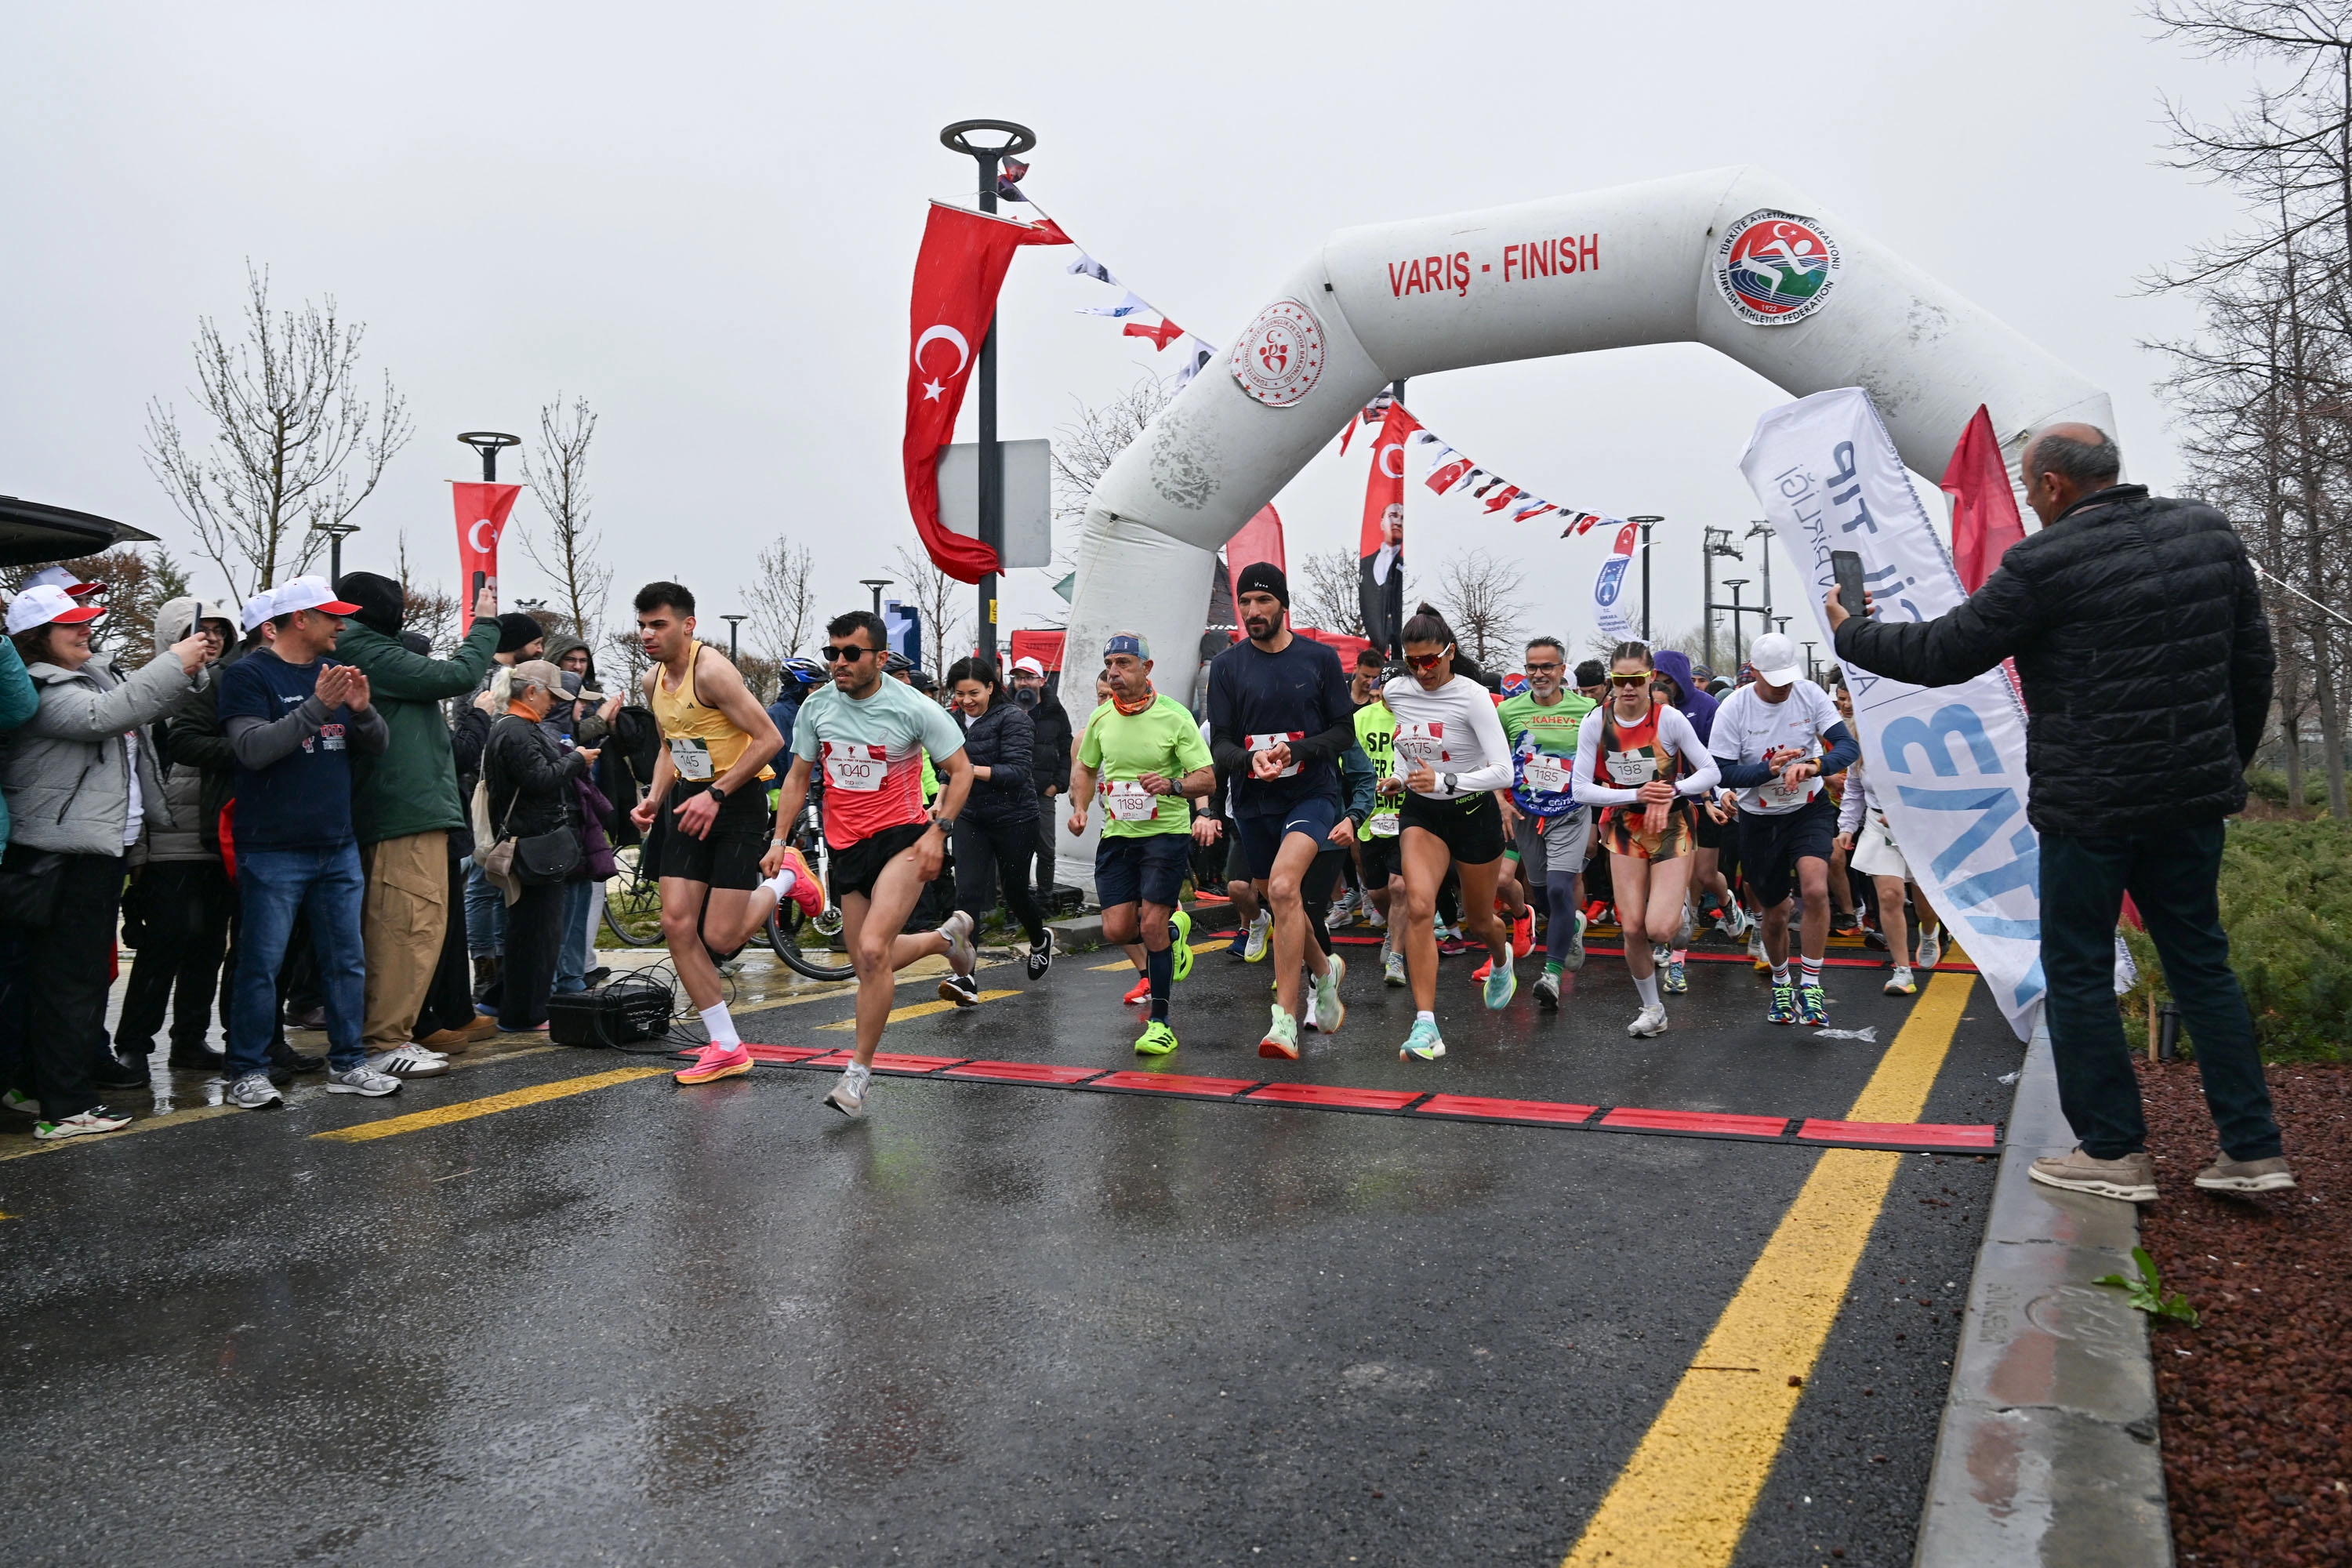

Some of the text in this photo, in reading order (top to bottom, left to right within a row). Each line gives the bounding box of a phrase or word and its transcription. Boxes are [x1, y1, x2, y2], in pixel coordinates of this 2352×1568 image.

[1719, 220, 1748, 256] TÜRKİYE
[1798, 217, 1840, 270] FEDERASYONU
[1388, 251, 1471, 297] VARIŞ
[1504, 233, 1599, 282] FINISH
[1719, 269, 1835, 324] TURKISH ATHLETIC FEDERATION
[1367, 732, 1394, 752] SP
[1404, 742, 1432, 753] 1175
[681, 755, 699, 768] 145
[838, 764, 870, 778] 1040
[1535, 769, 1559, 782] 1185
[1617, 764, 1642, 775] 198
[1117, 798, 1143, 810] 1189
[1455, 793, 1475, 805] NIKE
[1377, 822, 1396, 831] 1154
